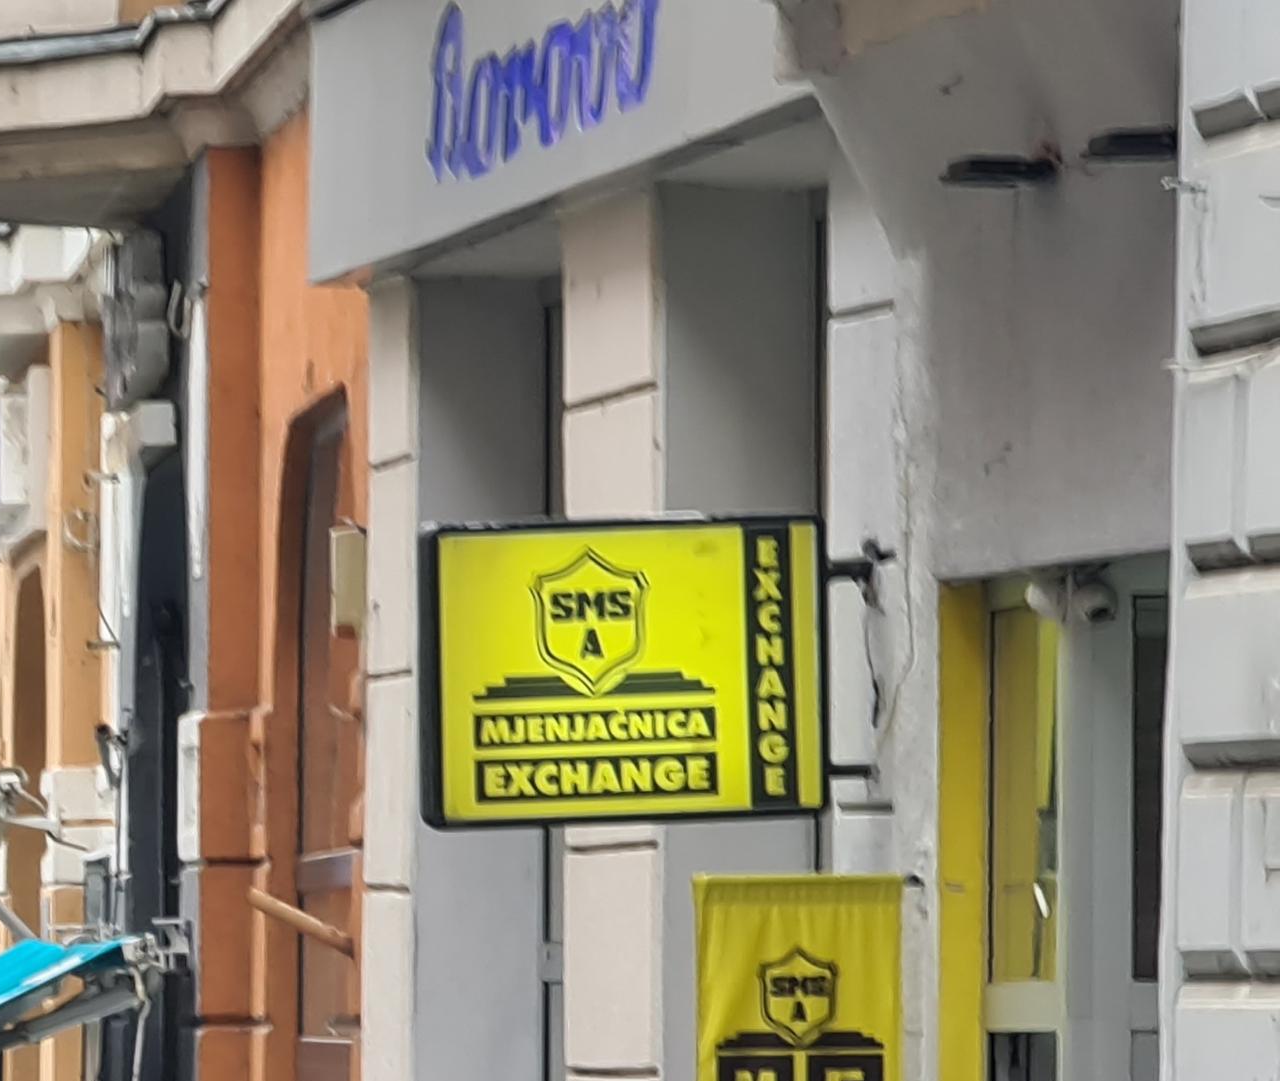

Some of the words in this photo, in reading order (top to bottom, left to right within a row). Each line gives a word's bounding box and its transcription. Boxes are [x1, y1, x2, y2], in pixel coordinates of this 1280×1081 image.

[550, 590, 632, 621] SMS
[580, 627, 605, 660] A
[752, 535, 790, 797] EXCHANGE
[480, 707, 711, 744] MJENJAČNICA
[483, 756, 711, 798] EXCHANGE
[790, 1000, 809, 1023] A
